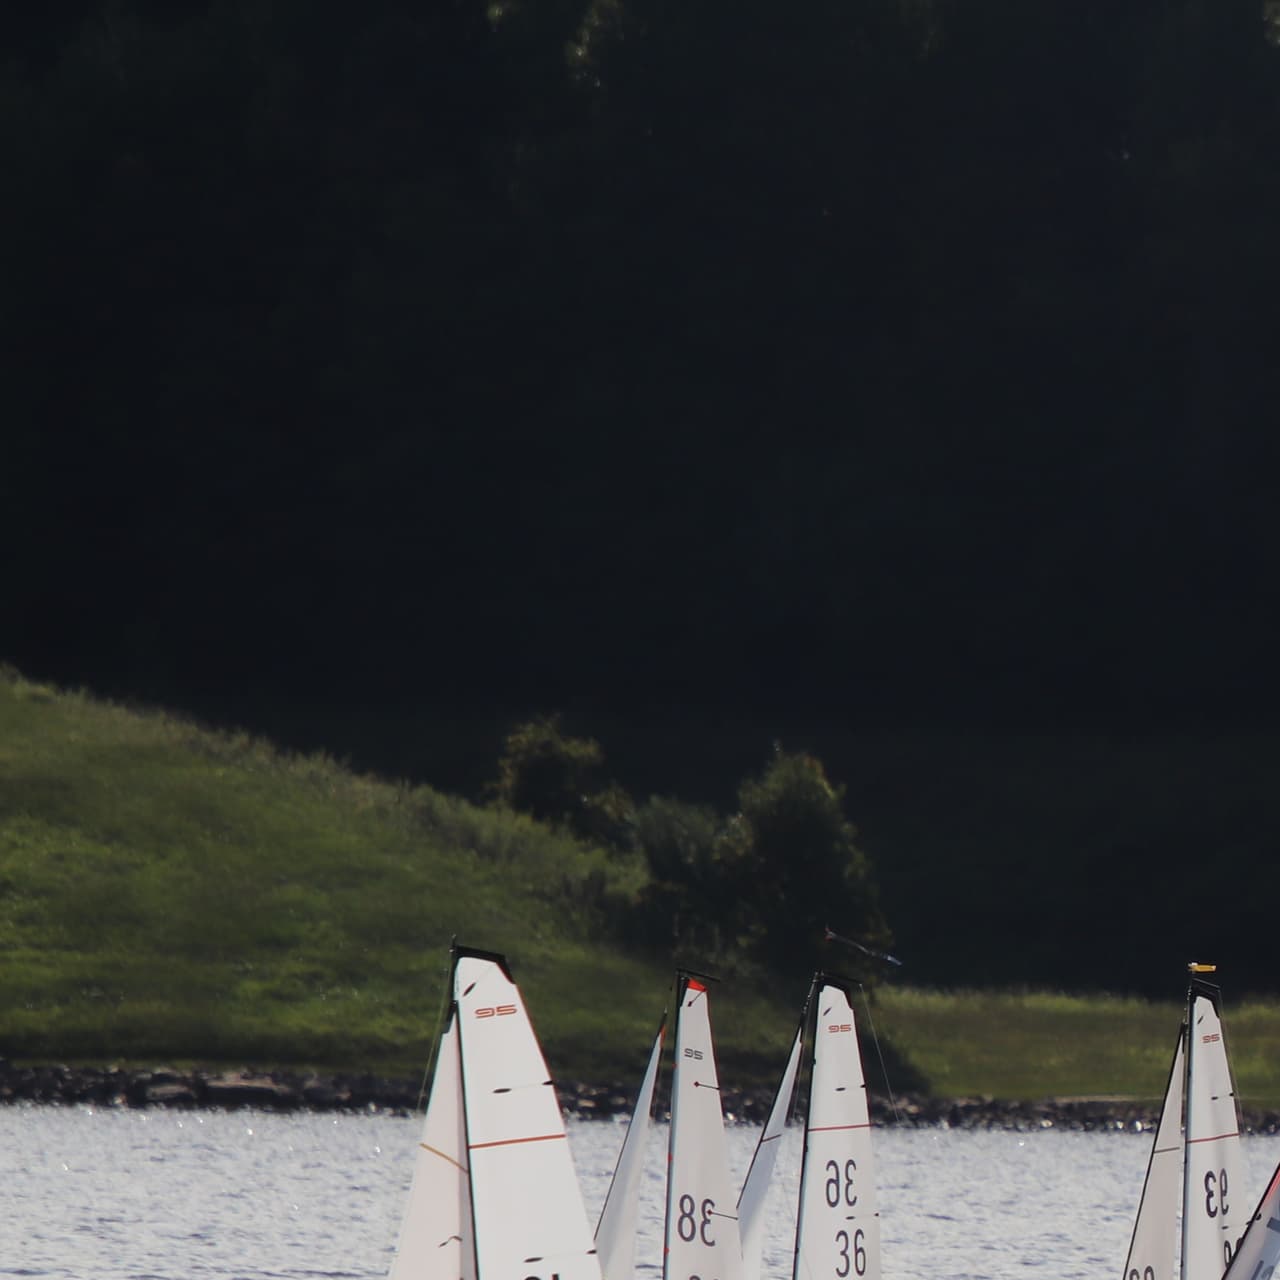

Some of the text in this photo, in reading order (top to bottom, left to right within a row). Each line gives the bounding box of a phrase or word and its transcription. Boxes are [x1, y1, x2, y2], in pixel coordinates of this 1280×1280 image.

[475, 1004, 518, 1019] 95
[828, 1024, 852, 1033] 95
[835, 1228, 867, 1278] 36
